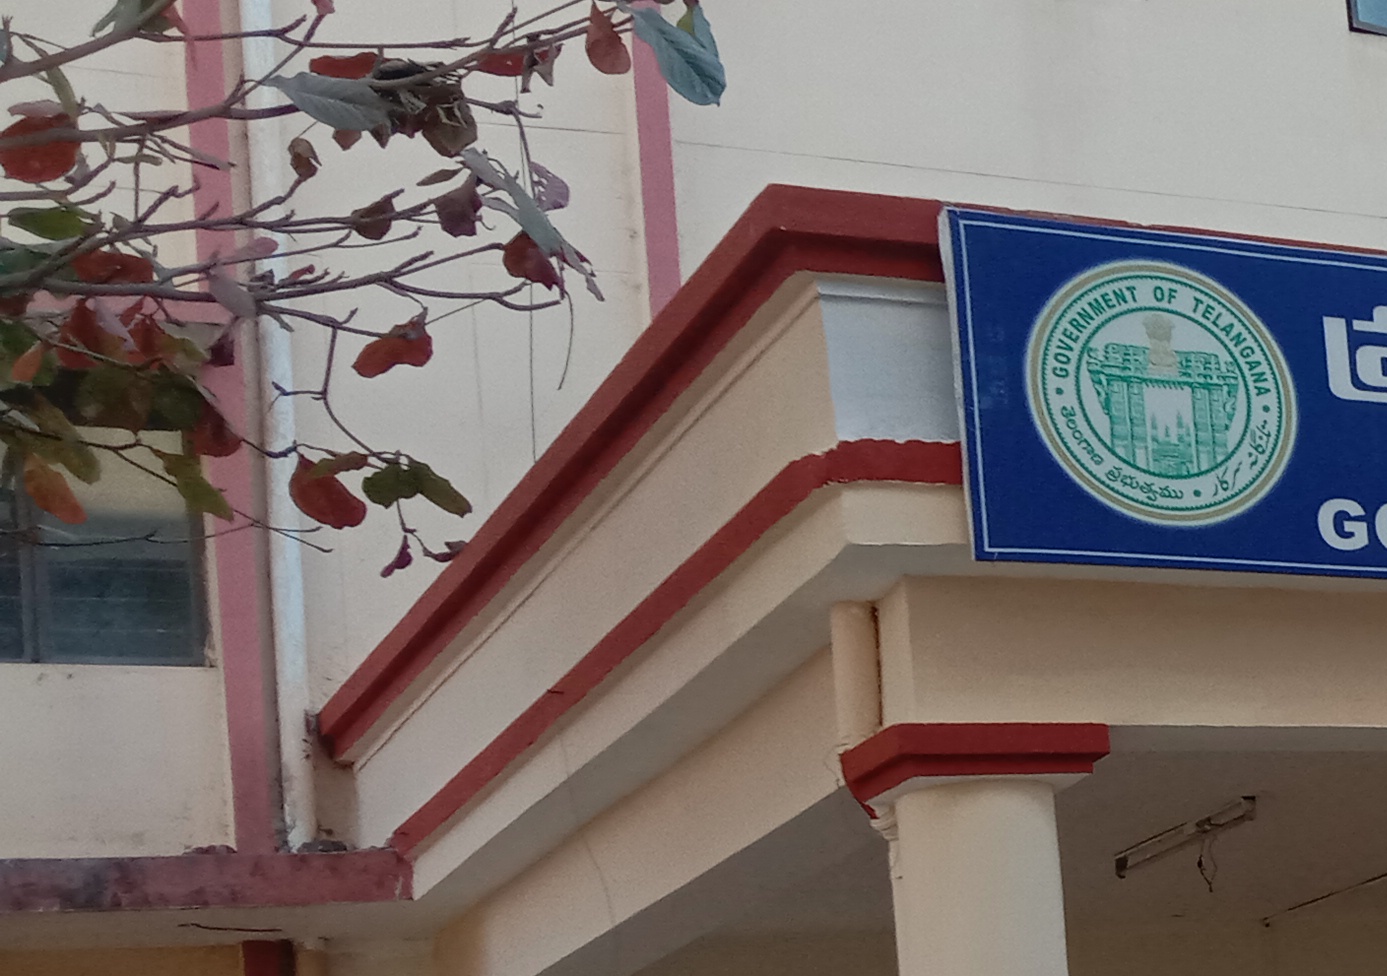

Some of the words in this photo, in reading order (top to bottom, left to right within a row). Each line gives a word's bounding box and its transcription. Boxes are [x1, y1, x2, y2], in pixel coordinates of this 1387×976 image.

[1052, 286, 1137, 378] GOVERNMENT
[1153, 286, 1178, 304] OF
[1191, 297, 1272, 397] TELANGANA
